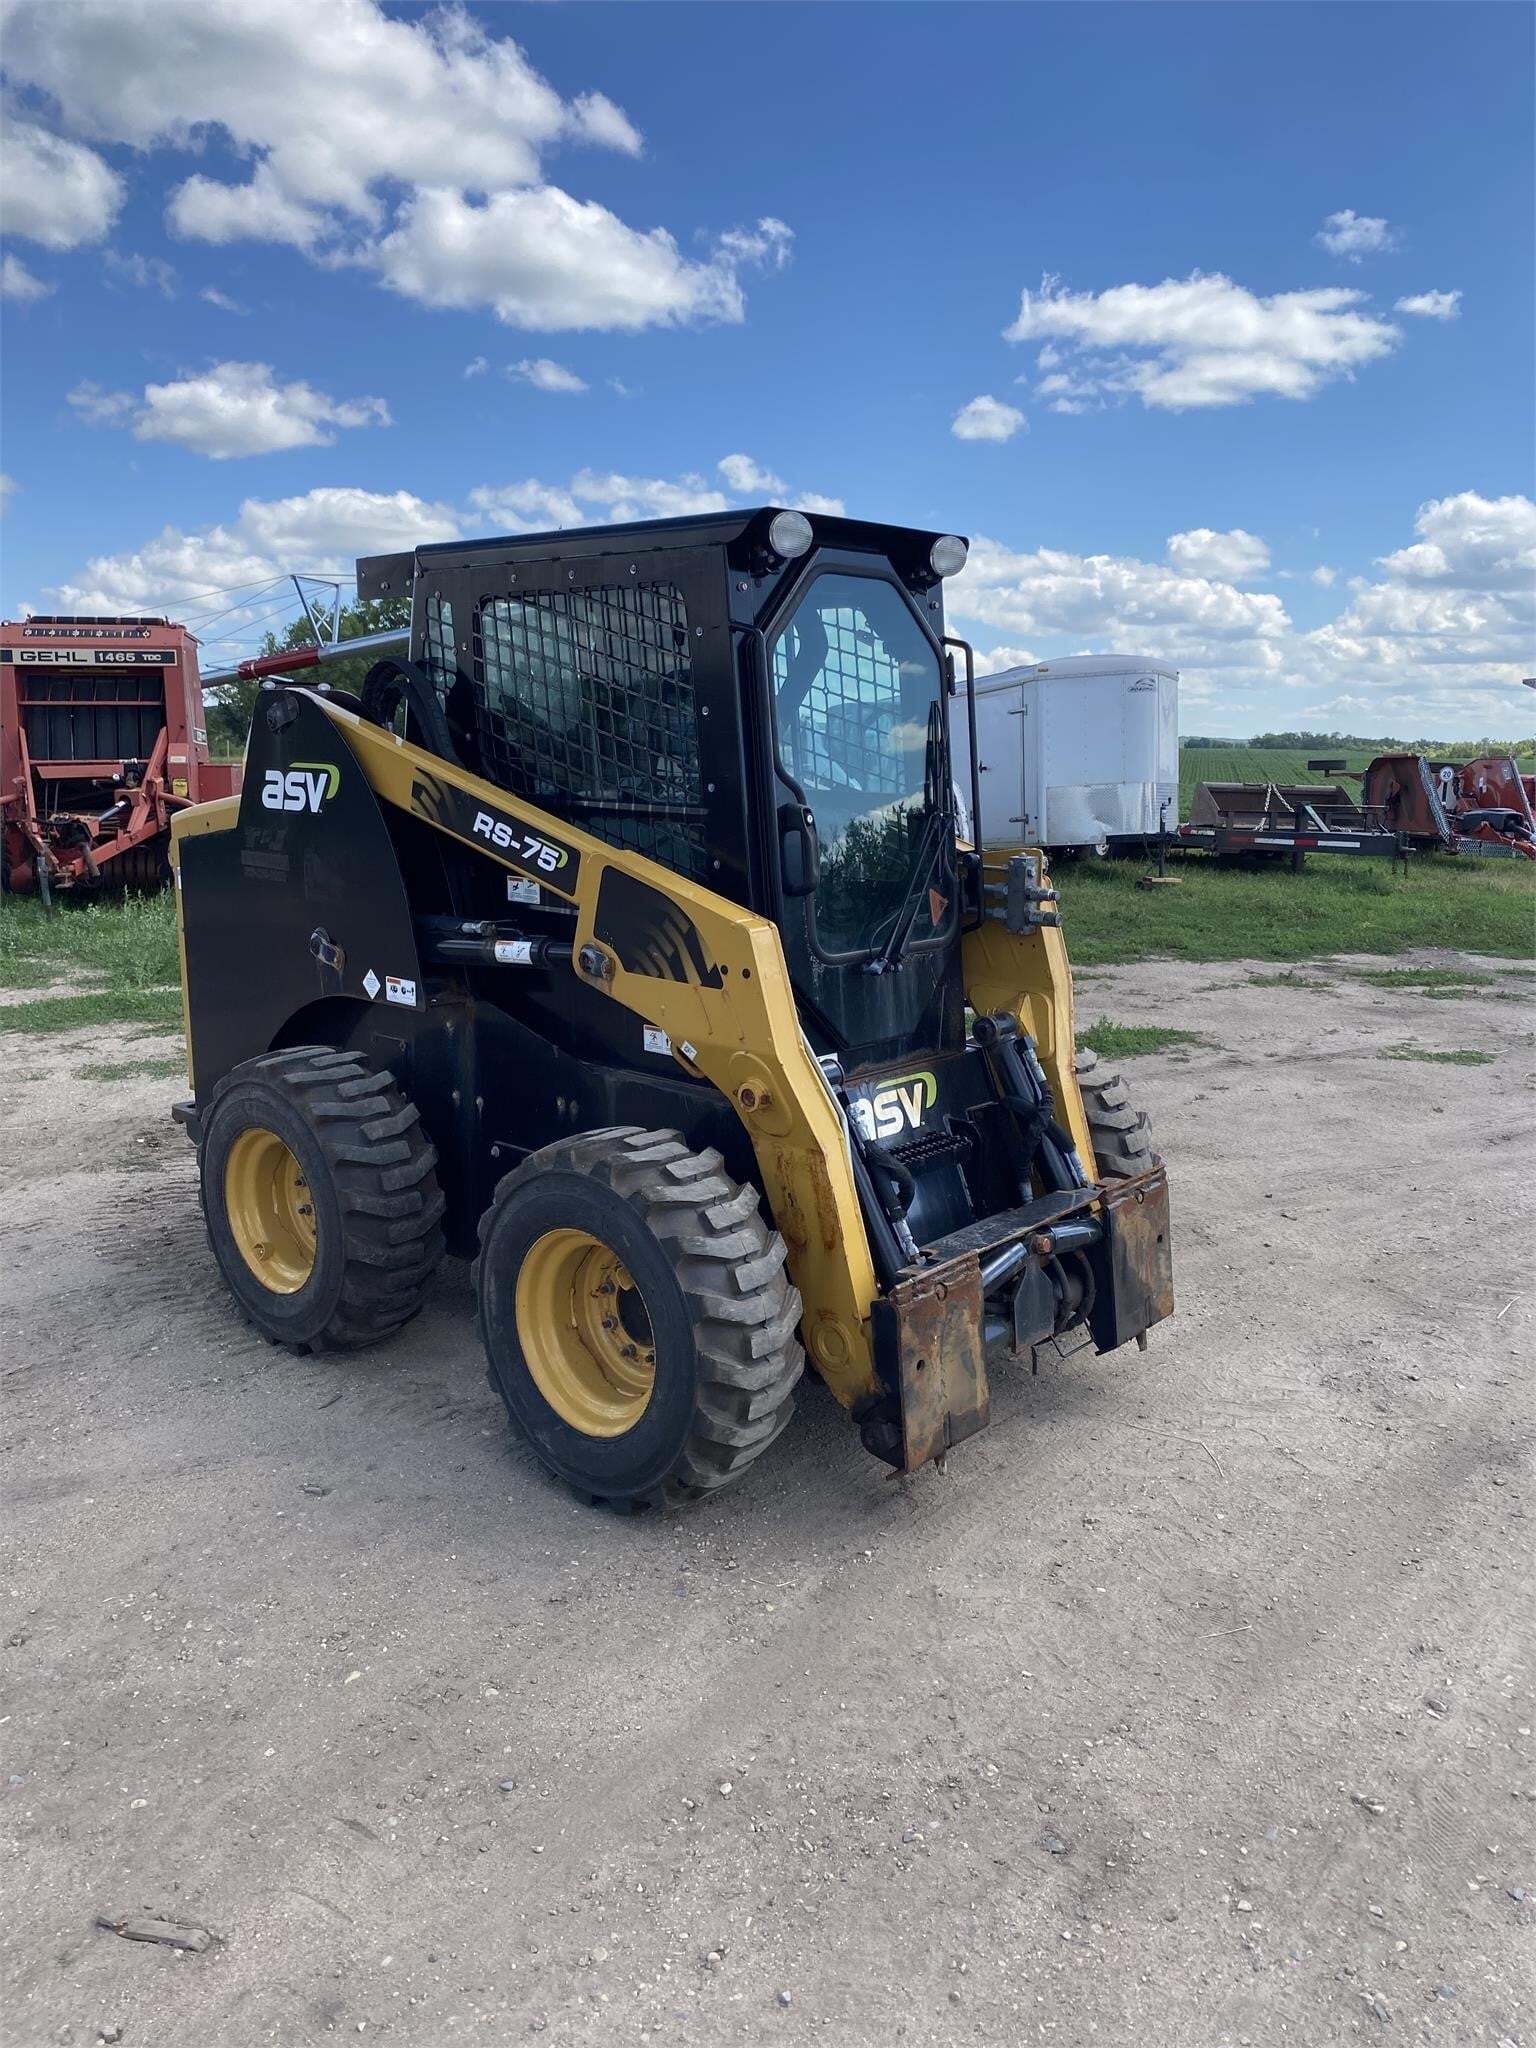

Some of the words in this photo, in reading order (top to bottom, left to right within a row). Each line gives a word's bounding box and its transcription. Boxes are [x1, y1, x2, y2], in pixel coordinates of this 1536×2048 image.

[20, 651, 87, 663] GEHL
[98, 652, 136, 663] 1465
[472, 811, 560, 872] RS-75
